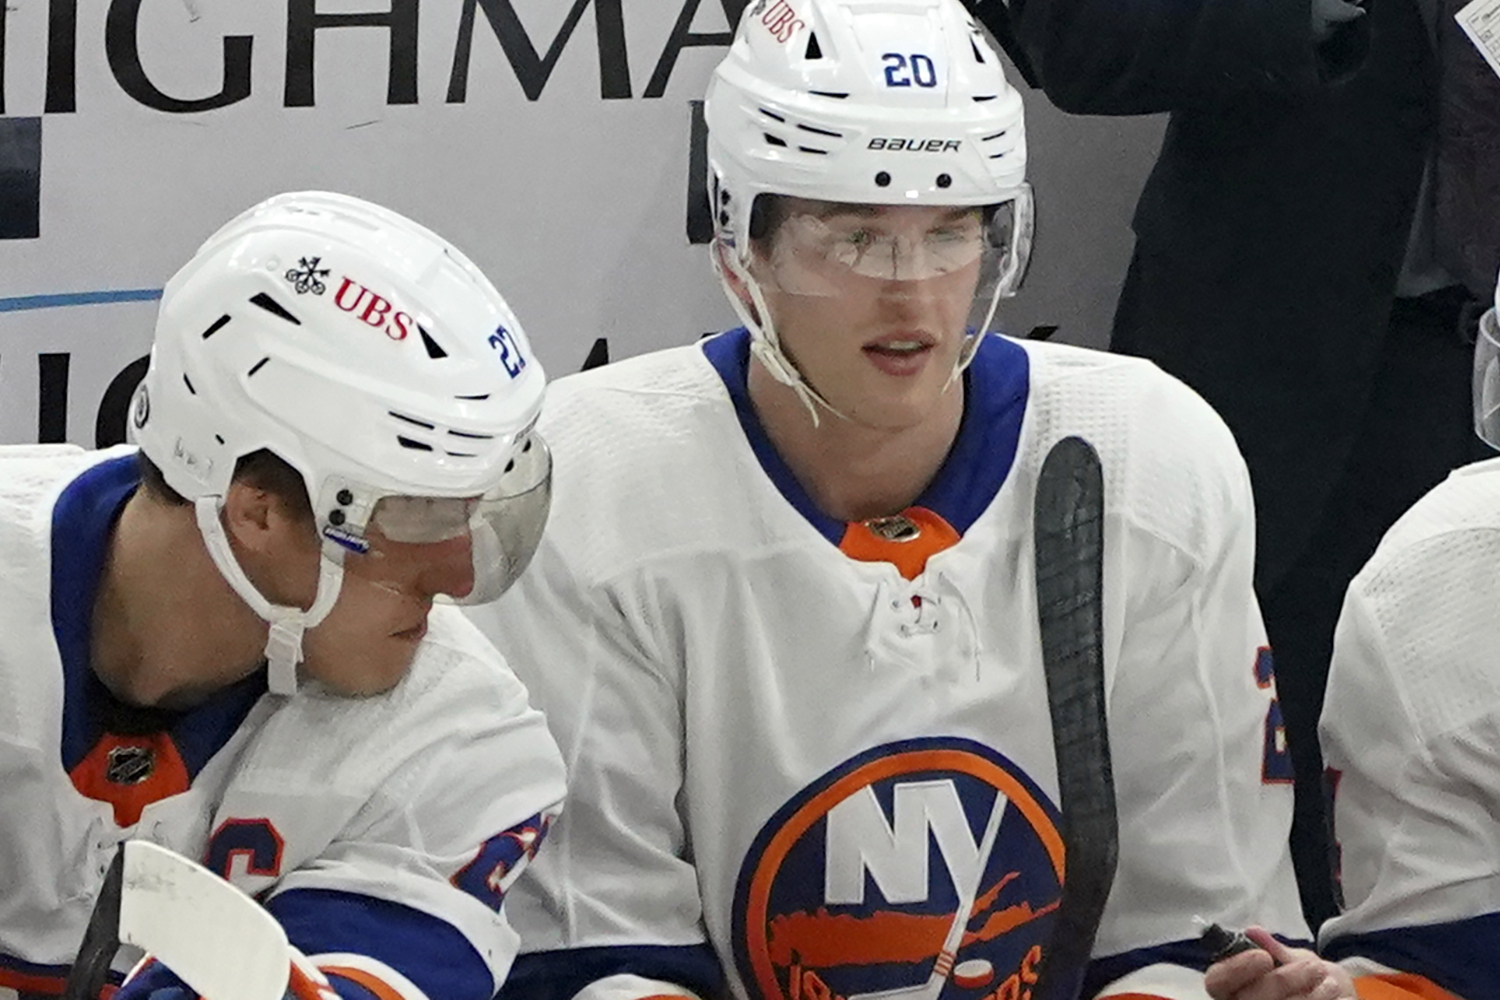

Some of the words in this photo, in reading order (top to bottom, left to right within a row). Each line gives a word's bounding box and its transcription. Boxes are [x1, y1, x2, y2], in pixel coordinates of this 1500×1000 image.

[881, 52, 937, 88] 20
[867, 137, 962, 153] BAUER
[333, 275, 413, 341] UBS
[488, 323, 527, 380] 27
[824, 778, 1008, 905] NY
